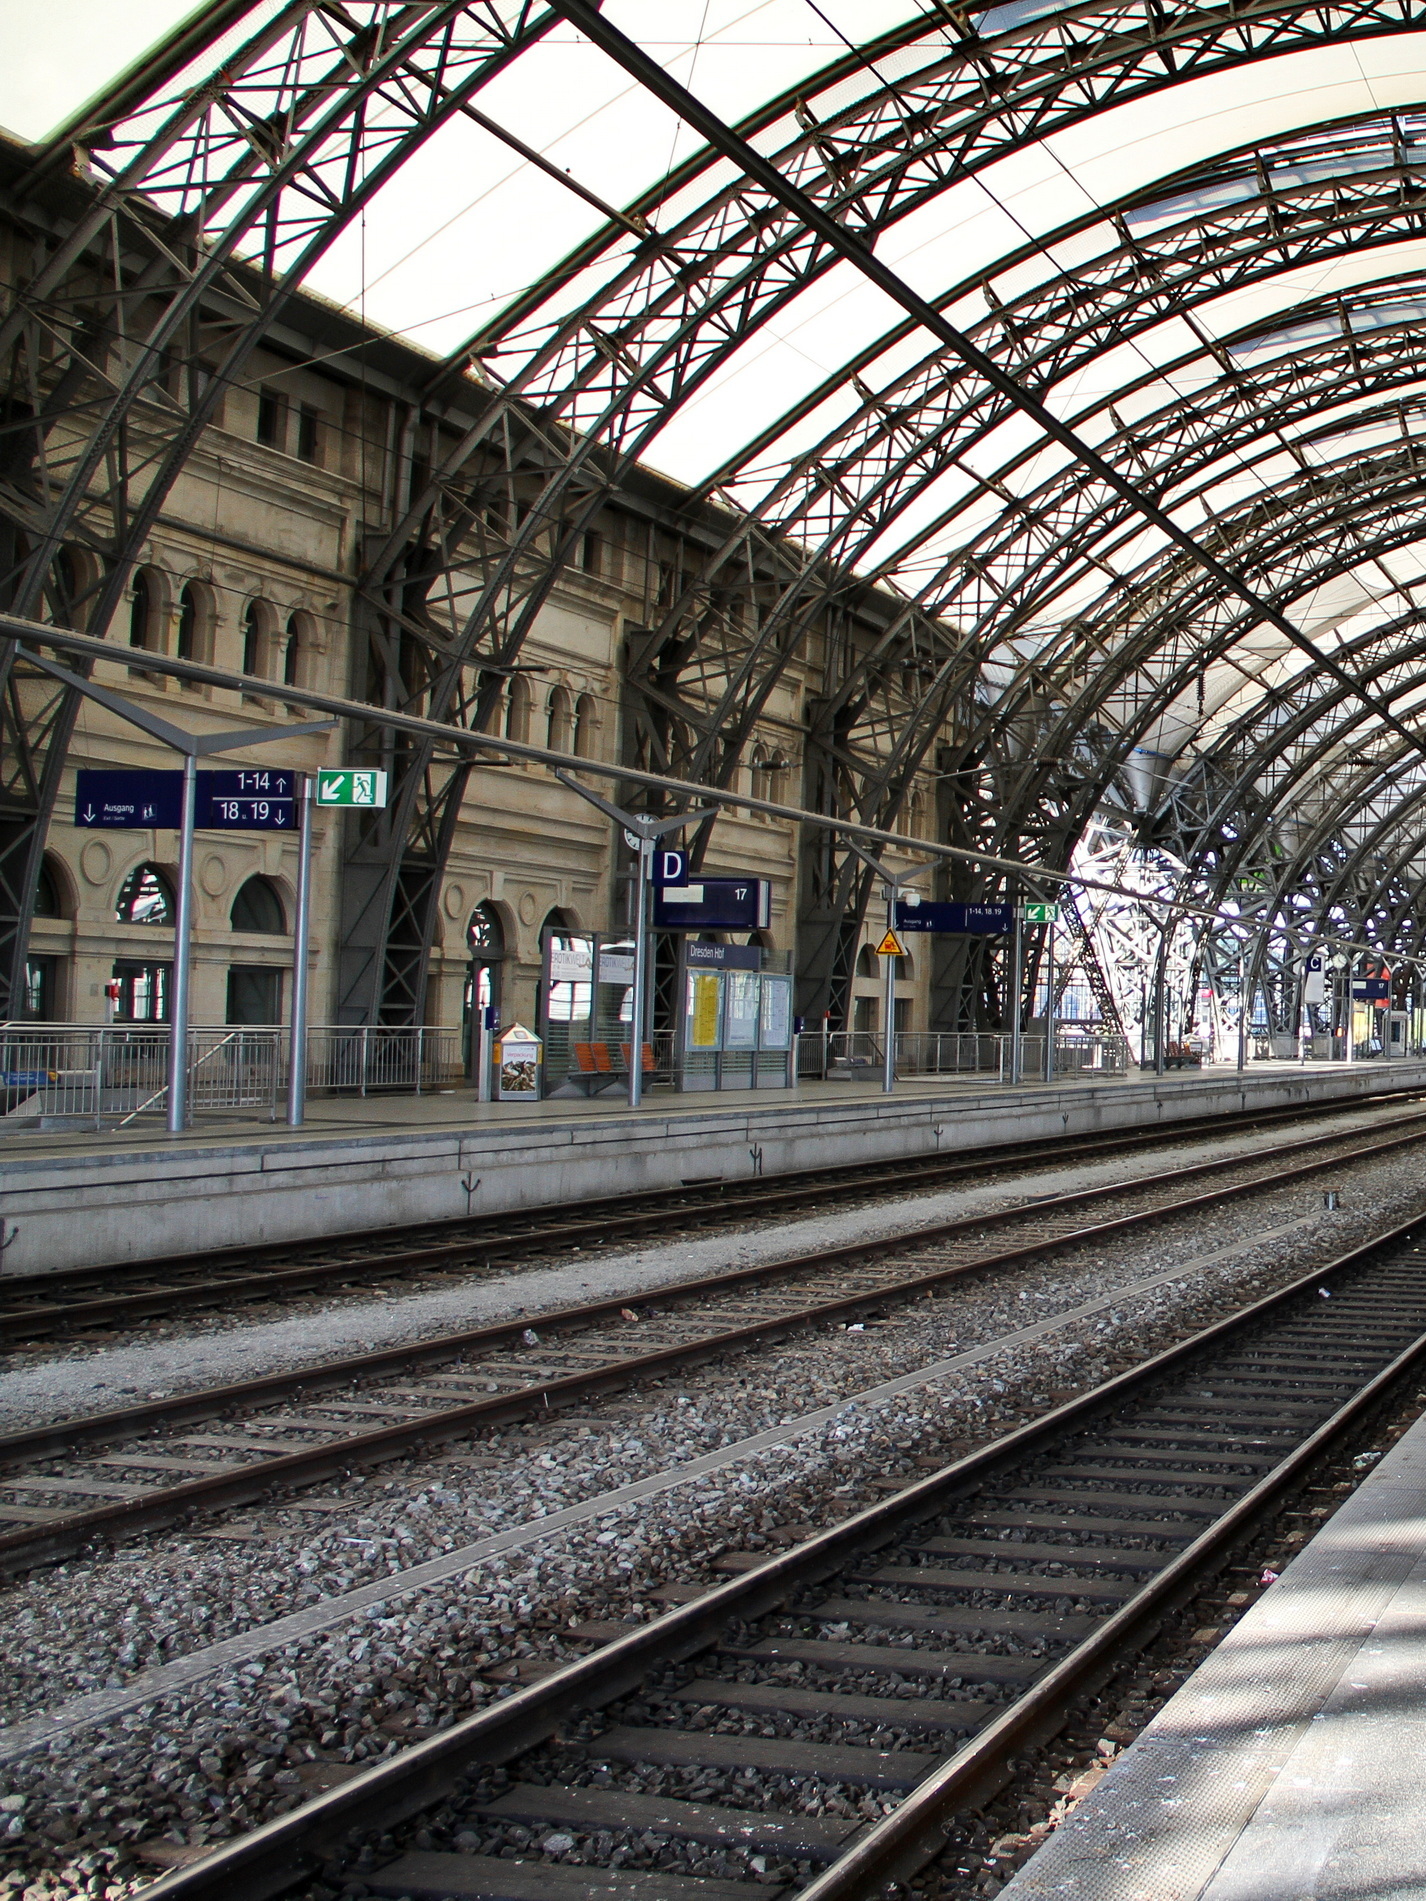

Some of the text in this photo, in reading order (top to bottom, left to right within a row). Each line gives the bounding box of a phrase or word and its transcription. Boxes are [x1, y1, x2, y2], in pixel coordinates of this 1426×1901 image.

[238, 772, 270, 790] 1-14
[103, 803, 134, 814] Ausgang
[221, 802, 239, 820] 18
[251, 802, 269, 820] 19
[663, 852, 682, 879] D
[734, 888, 747, 900] 17
[690, 945, 725, 959] Dresden Hbf
[1310, 958, 1319, 969] C
